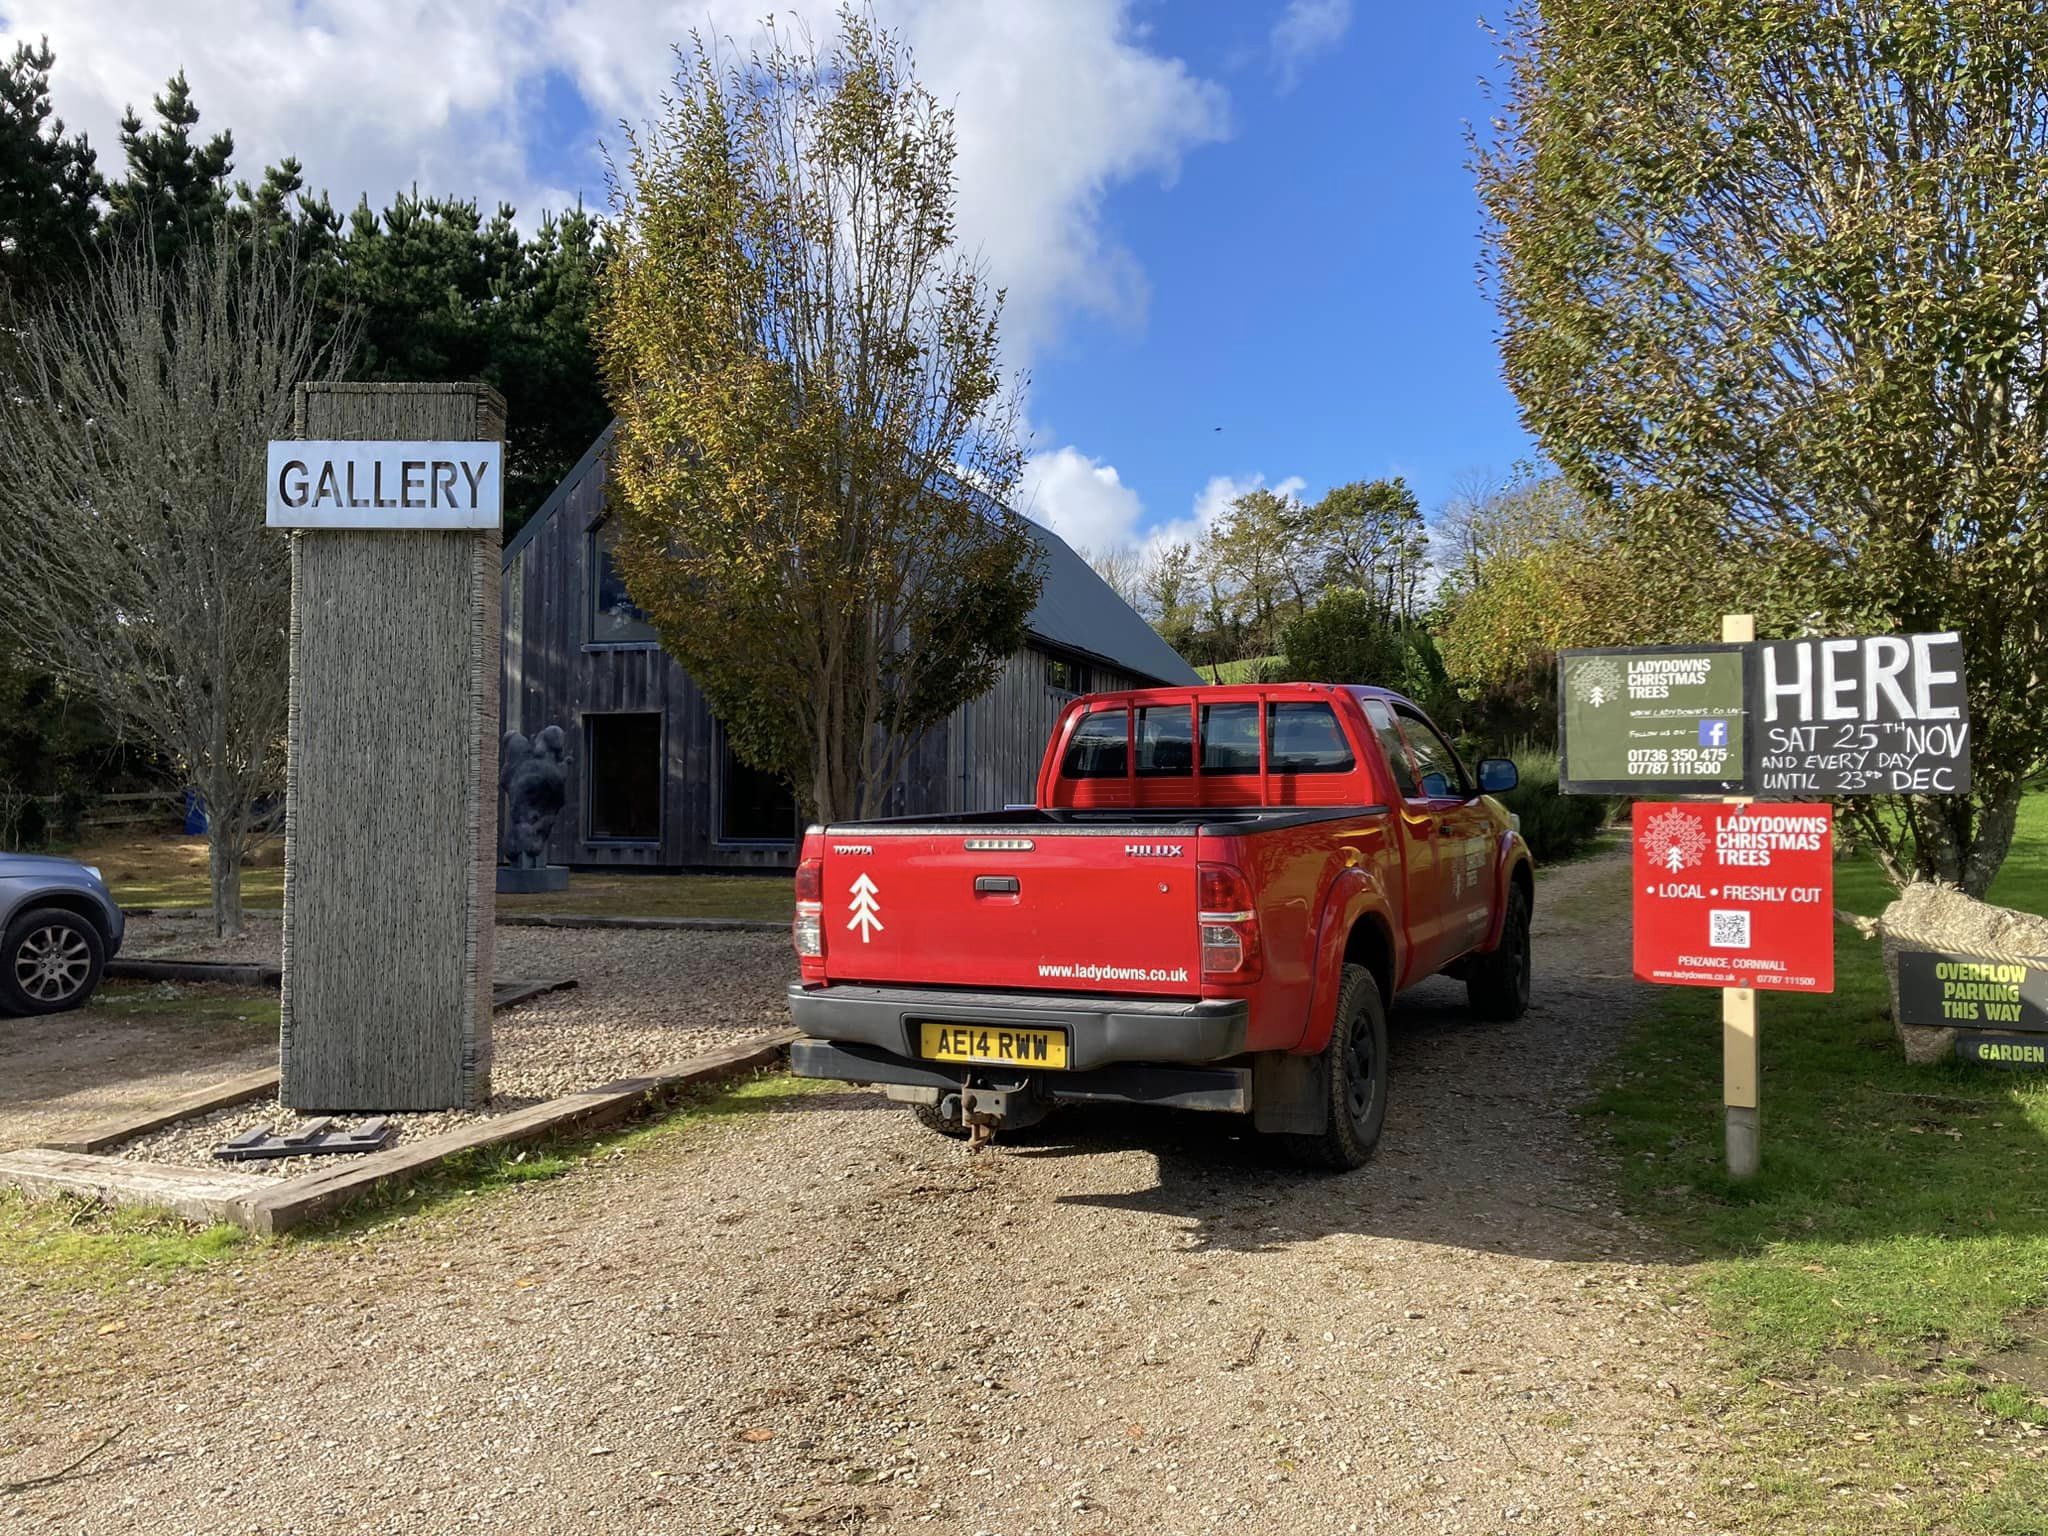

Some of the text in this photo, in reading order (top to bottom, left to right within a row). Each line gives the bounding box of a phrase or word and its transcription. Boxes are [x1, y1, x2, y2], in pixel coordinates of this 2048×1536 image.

[279, 460, 489, 508] GALLERY
[1627, 658, 1711, 674] LADYDOWNS
[1627, 672, 1706, 686] CHRISTMAS
[1763, 632, 1961, 723] HERE
[1627, 686, 1669, 699] TREES
[1768, 726, 1829, 753] SAT
[1906, 723, 1968, 758] NOV
[1627, 748, 1727, 762] 01736 350 475
[1761, 751, 1919, 770] AND EVERY DAY
[1627, 762, 1669, 775] 07787
[1763, 773, 1820, 790] UNTIL
[1893, 768, 1955, 791] DEC
[1716, 815, 1828, 834] LADYDOWNS
[833, 845, 873, 856] TOYOTA
[1125, 845, 1183, 857] HILUX
[1716, 833, 1821, 851] CHRISTMAS
[1716, 849, 1770, 866] TREES
[1659, 883, 1822, 903] LOCAL FRESHLY CUT
[1038, 963, 1188, 982] www.ladydowns.co.uk
[1678, 955, 1788, 971] PENZANCE, CORNWALL
[1935, 962, 2027, 983] OVERFLOW
[1944, 982, 2020, 1002] PARKING
[1942, 1001, 2023, 1022] THIS WAY
[938, 1029, 1048, 1061] AE14 RWW
[1978, 1043, 2045, 1063] GARDEN
